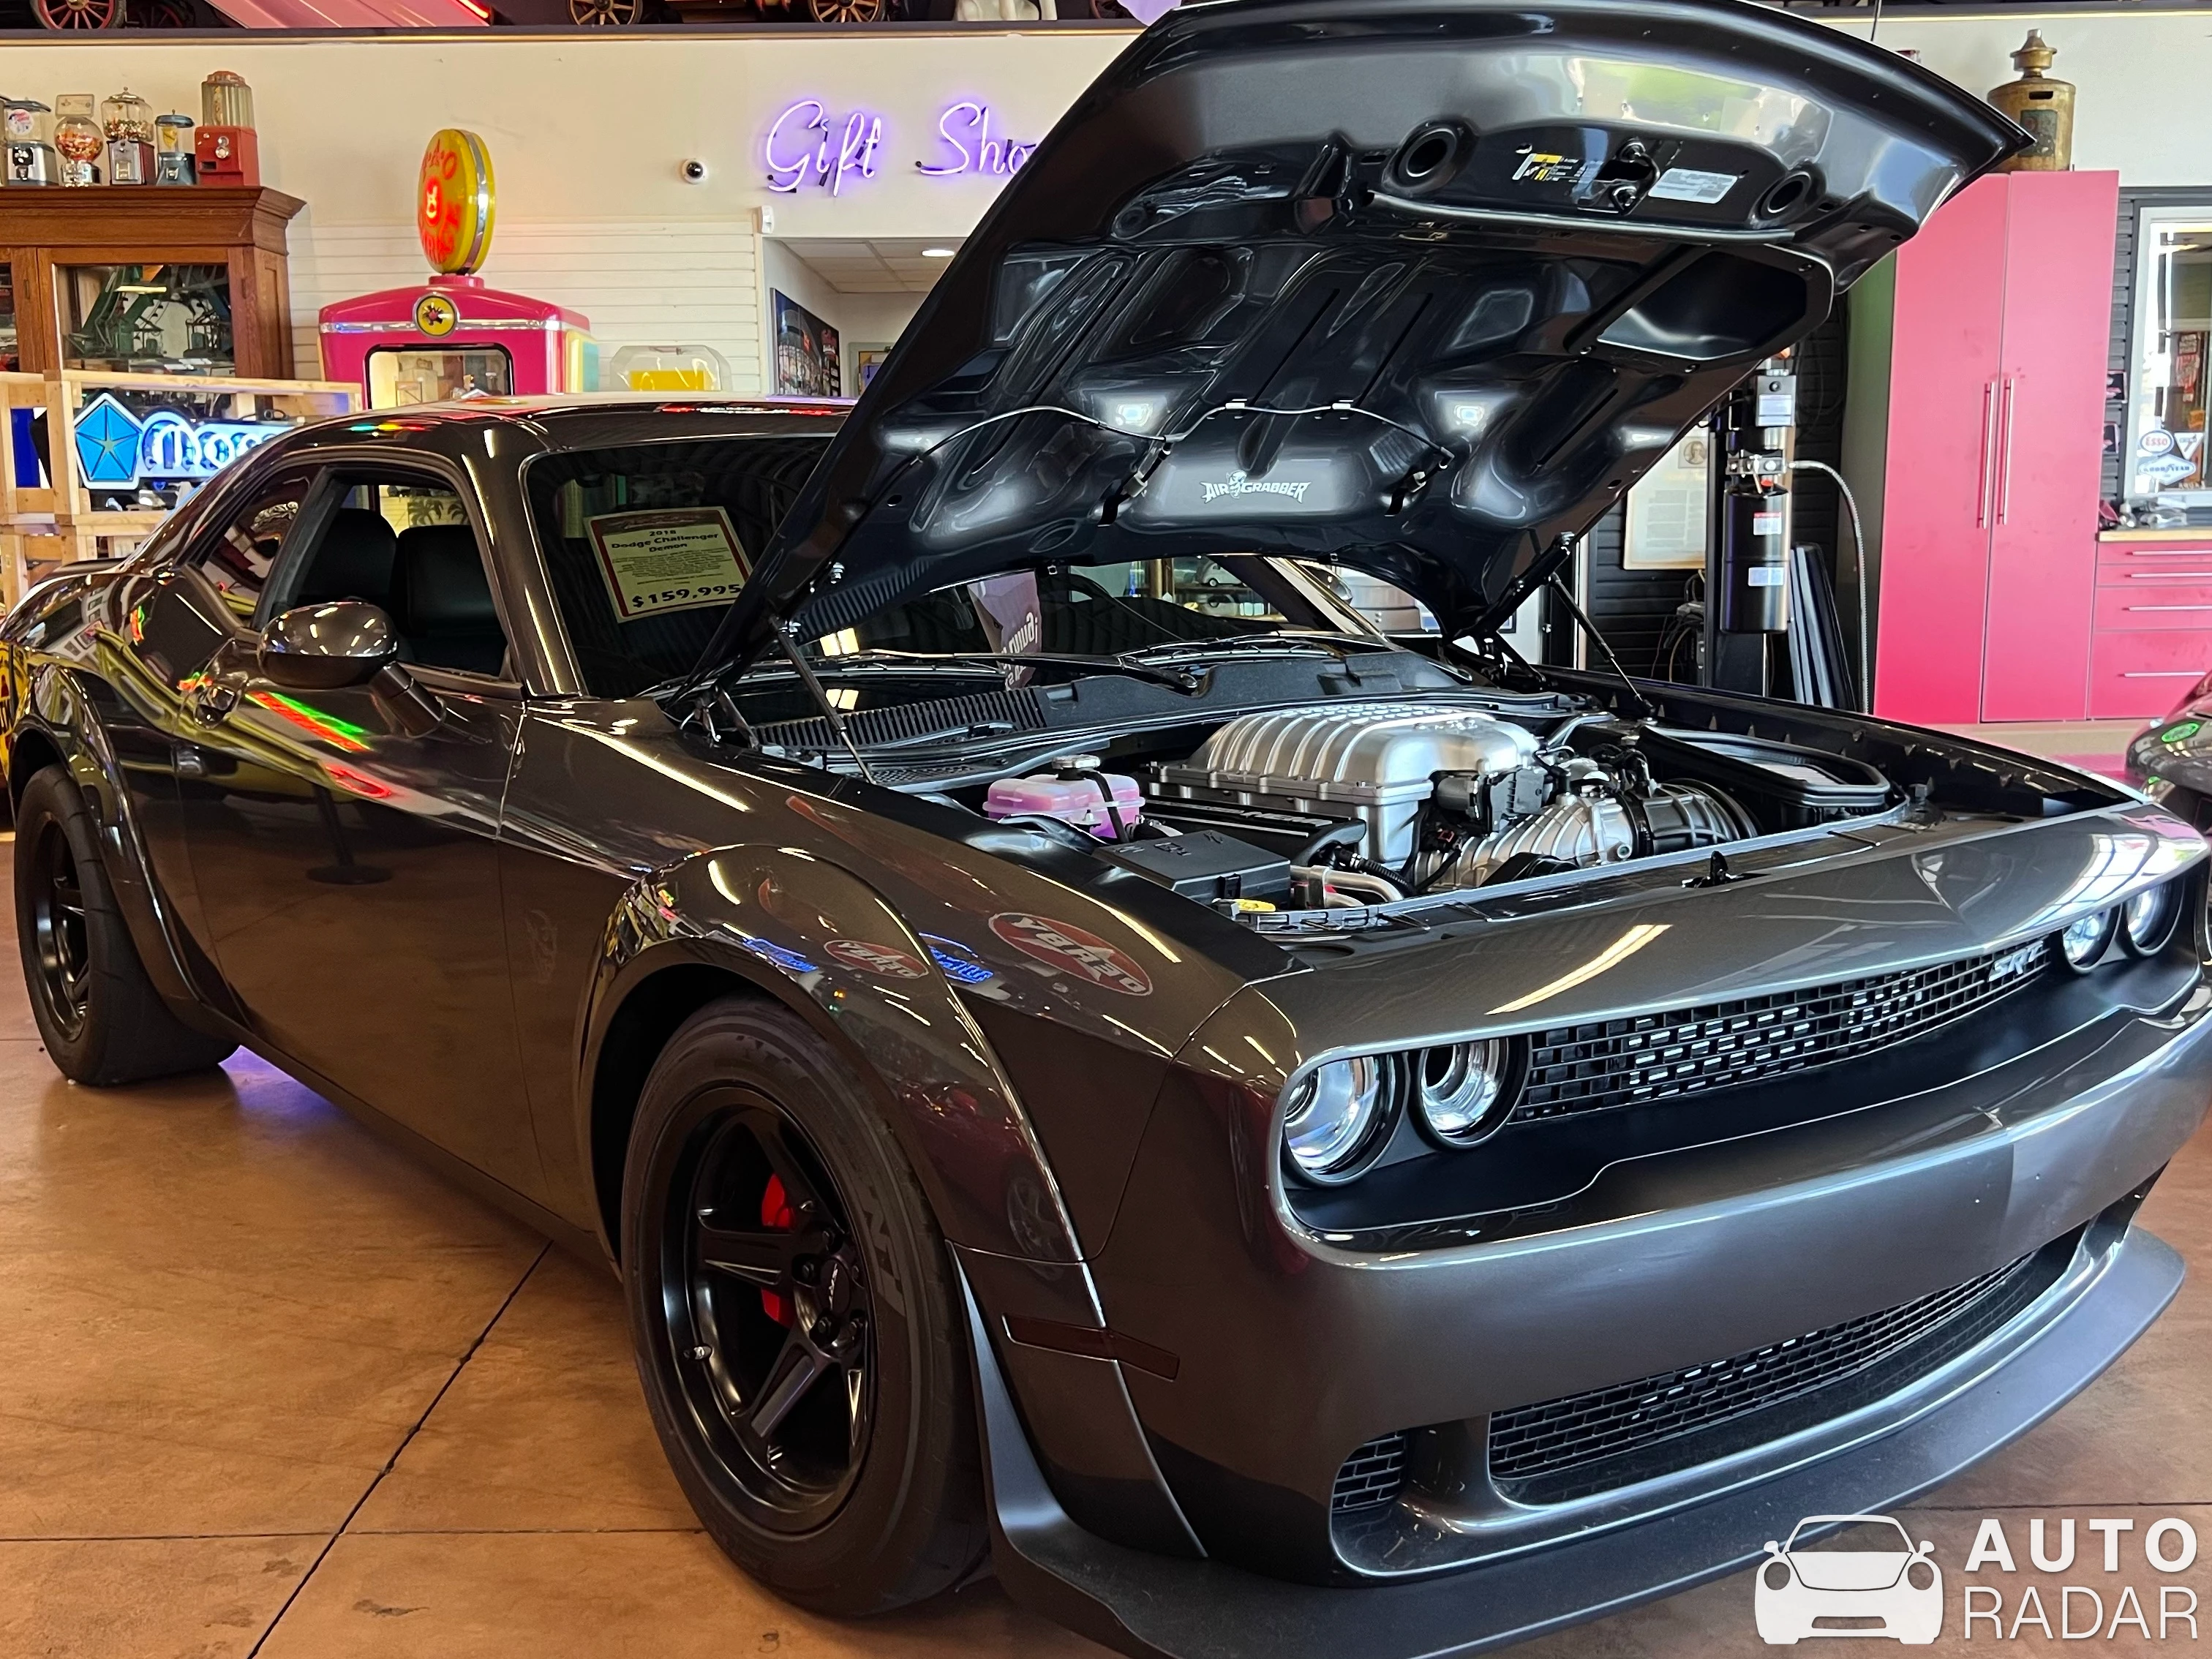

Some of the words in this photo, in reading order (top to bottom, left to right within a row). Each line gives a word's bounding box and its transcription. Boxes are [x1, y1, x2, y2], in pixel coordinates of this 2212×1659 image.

[767, 101, 881, 196] Gift
[919, 102, 1028, 175] Sho
[1200, 481, 1230, 504] AIR
[1240, 481, 1312, 504] GRABBER
[611, 539, 652, 549] Dodge
[653, 533, 719, 544] Challenger
[649, 529, 677, 537] 2018
[649, 542, 688, 553] Demon
[632, 583, 742, 609] $159,995
